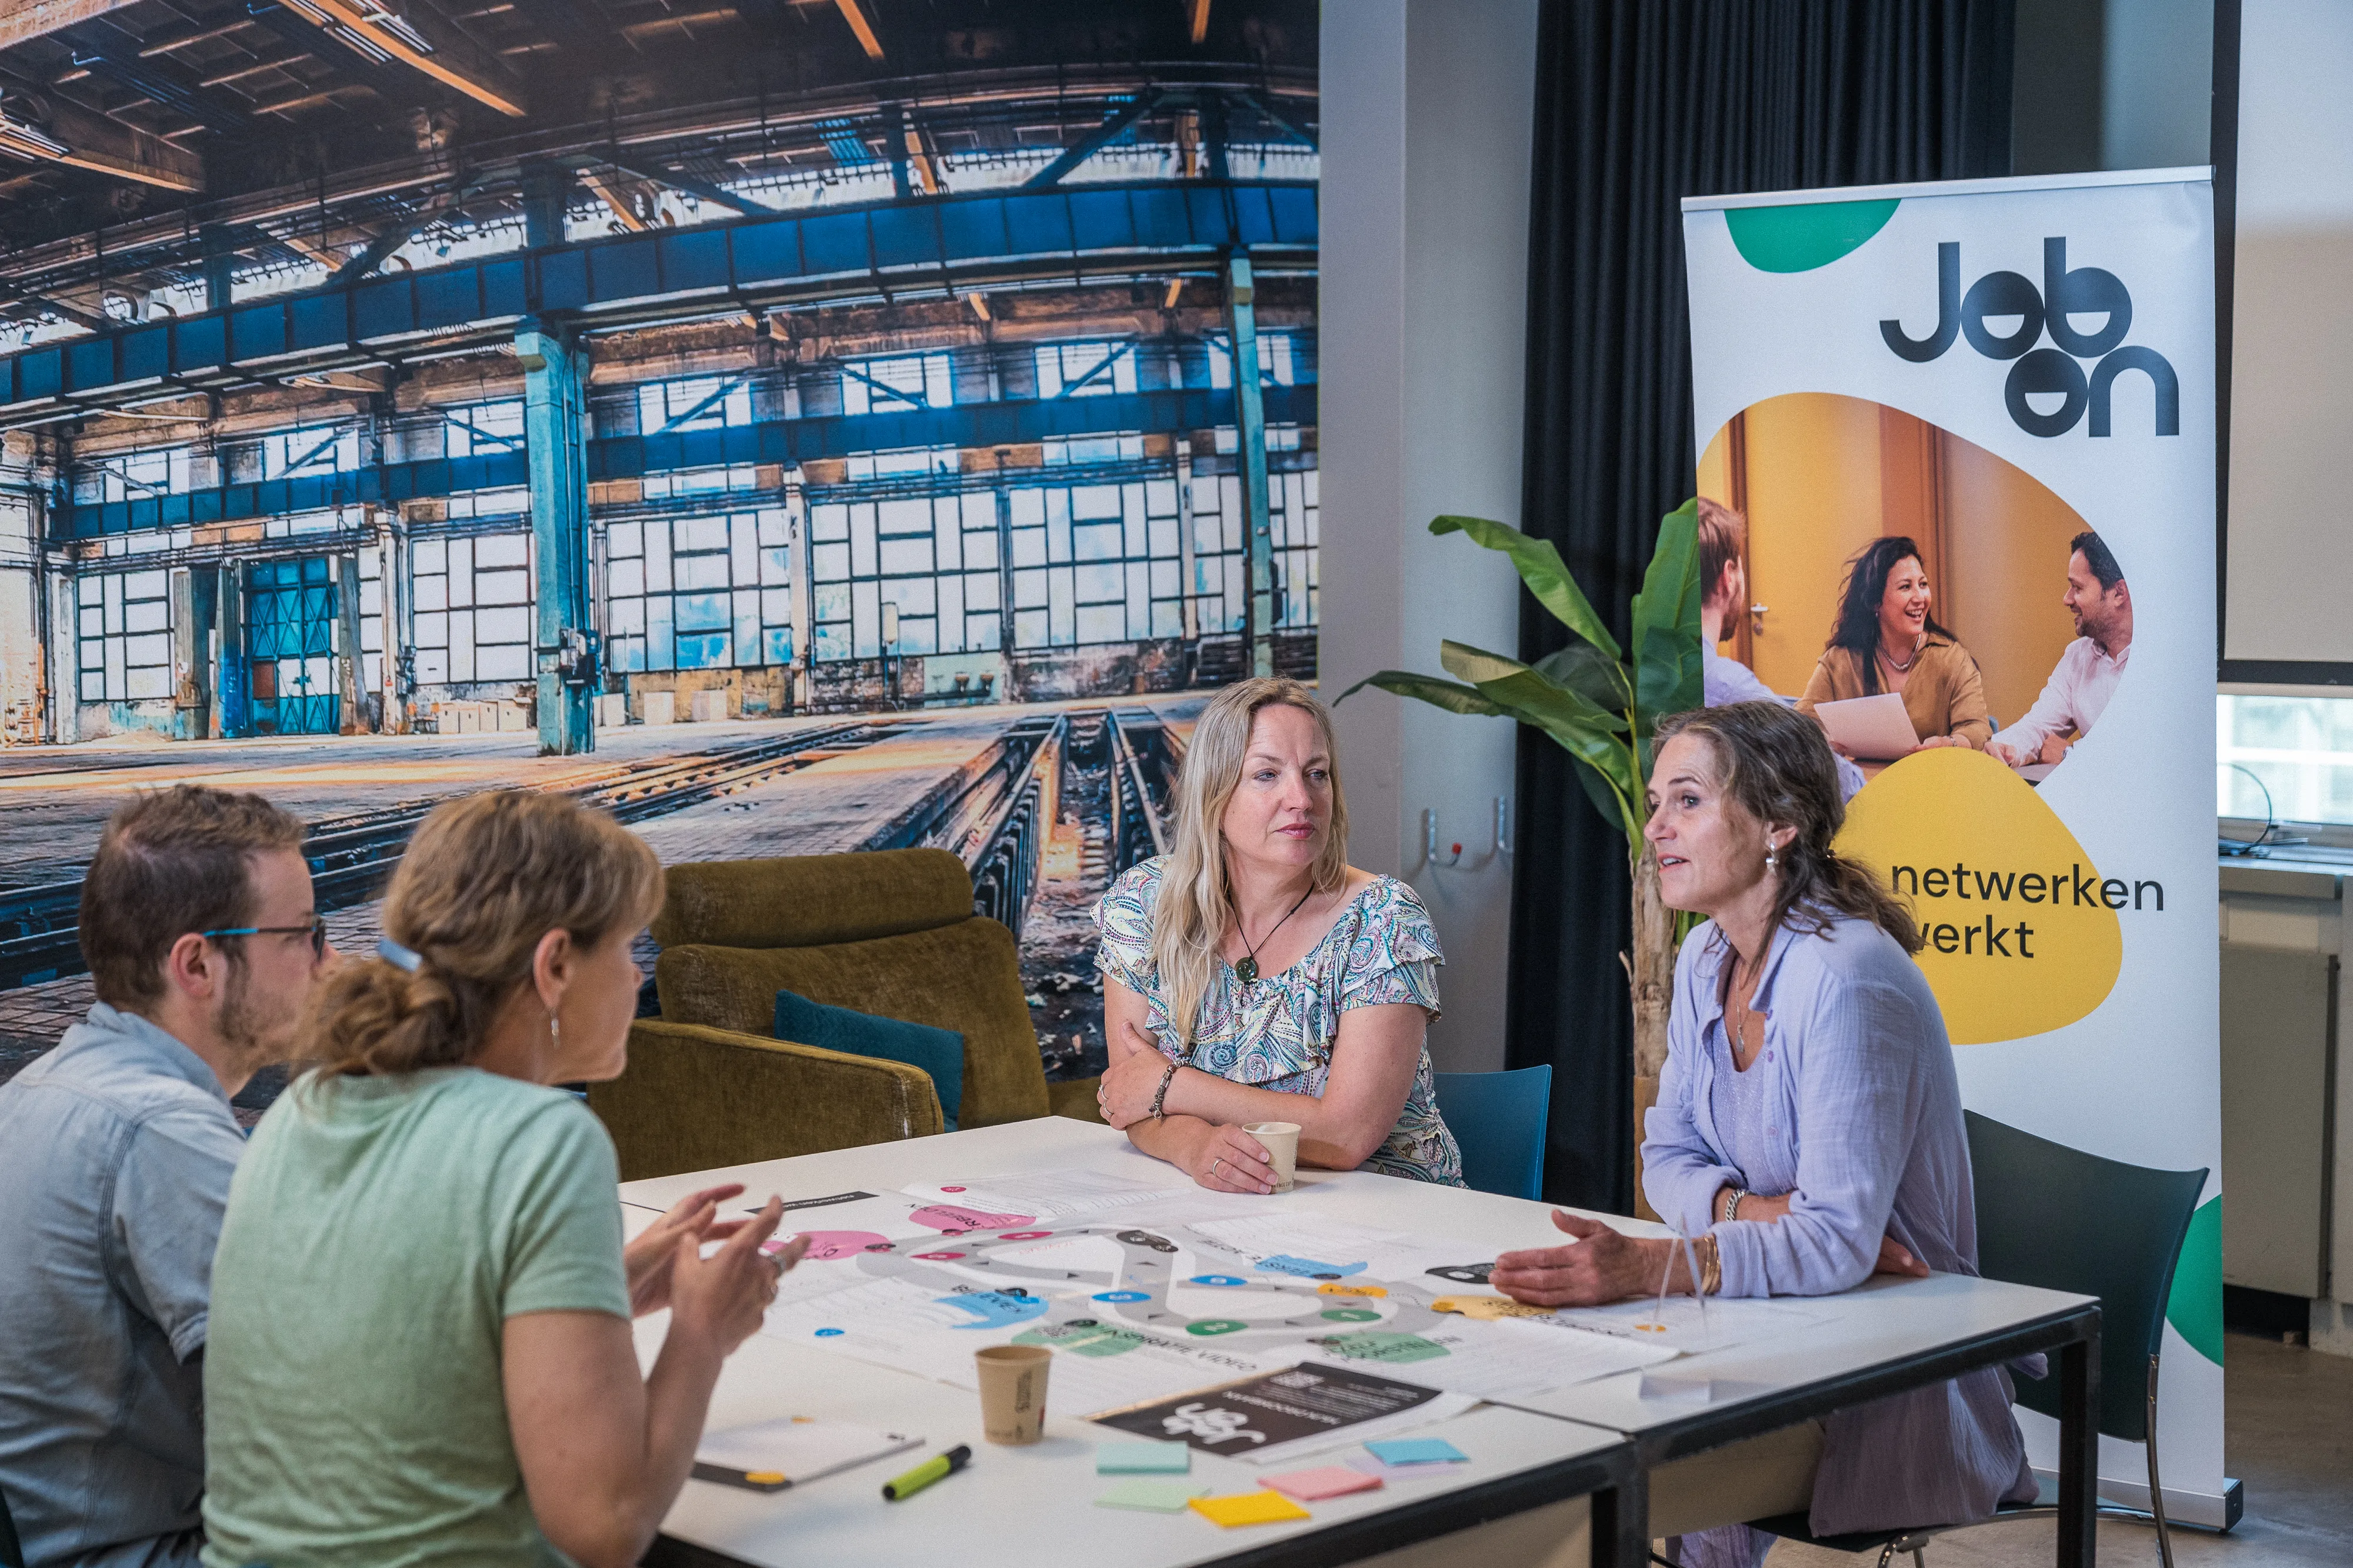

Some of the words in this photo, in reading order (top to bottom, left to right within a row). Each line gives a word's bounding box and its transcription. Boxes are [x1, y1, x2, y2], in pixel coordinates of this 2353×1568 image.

[1879, 236, 2132, 362] Job
[2005, 345, 2179, 438] on
[1891, 863, 2164, 911] netwerken
